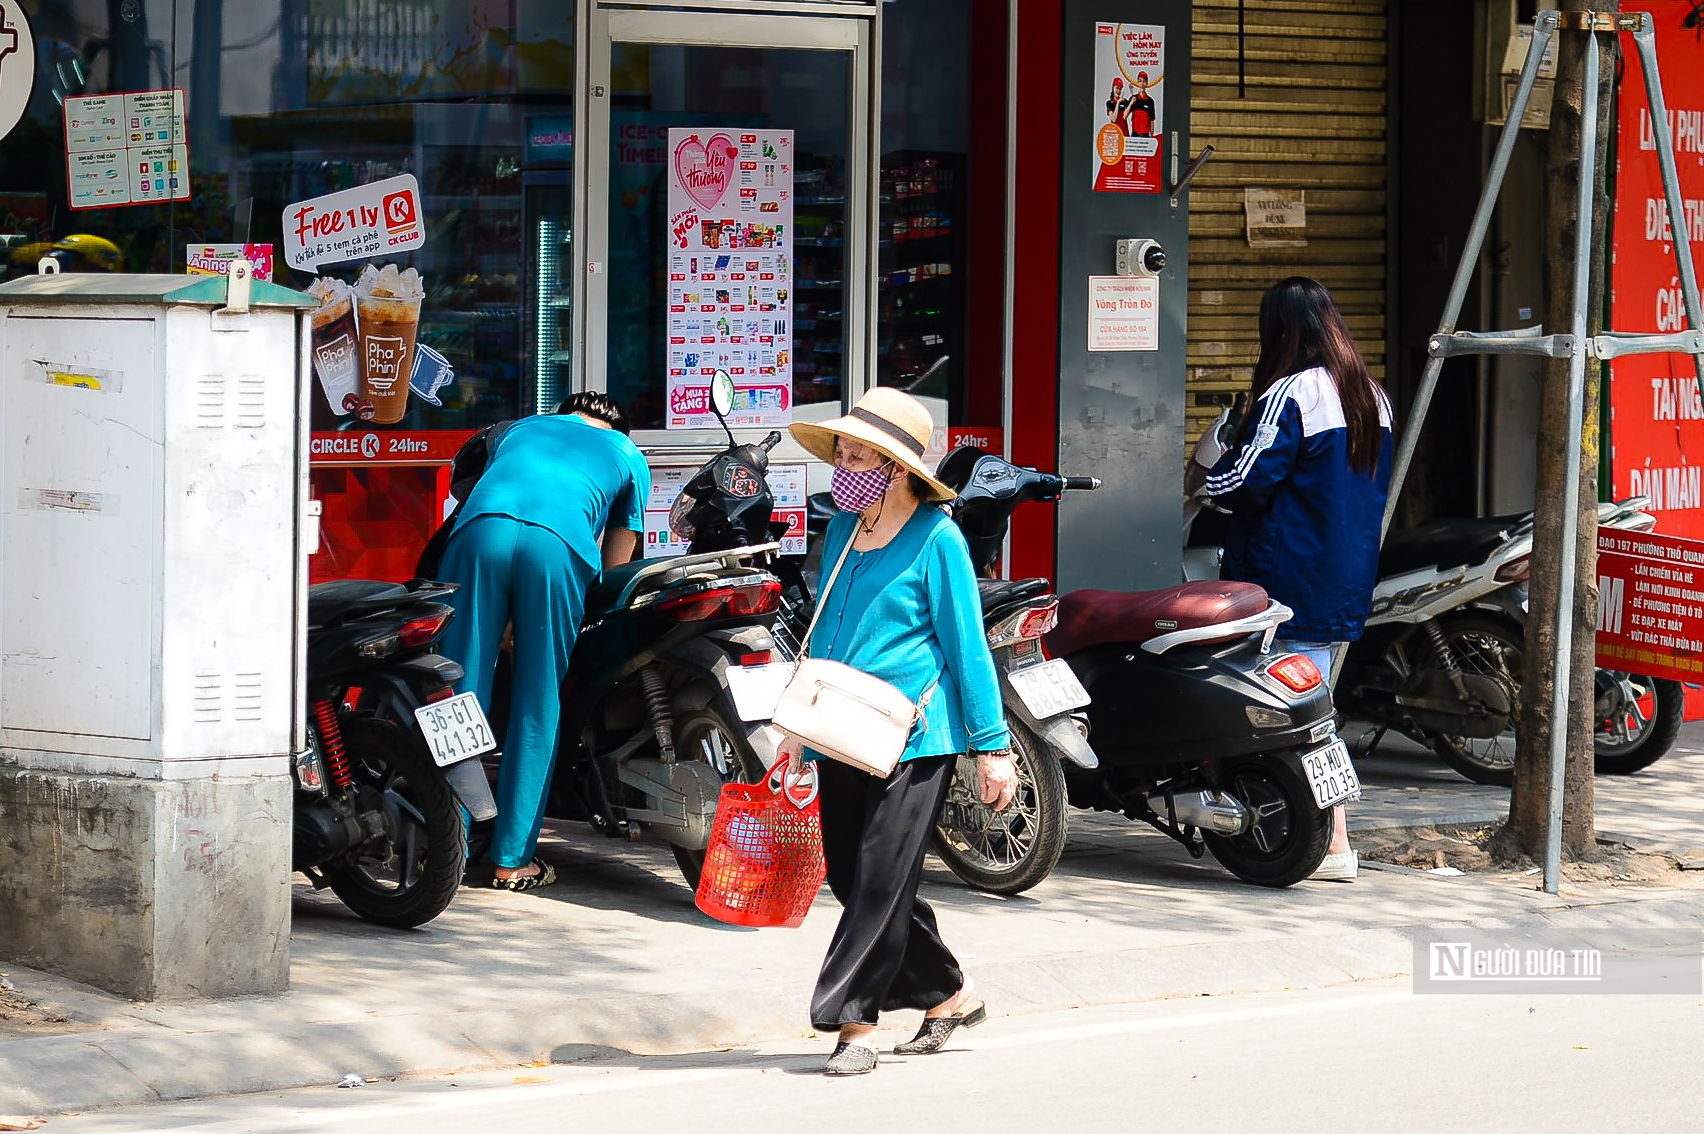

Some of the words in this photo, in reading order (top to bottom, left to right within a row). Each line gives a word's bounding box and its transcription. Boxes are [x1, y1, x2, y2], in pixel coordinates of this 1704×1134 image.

[1122, 32, 1137, 42] VIỆC
[1138, 32, 1153, 41] LÀM
[706, 150, 726, 175] Yêu
[686, 163, 725, 192] thương
[294, 206, 345, 246] Free
[346, 208, 356, 228] 1
[360, 205, 378, 228] ly
[673, 214, 698, 241] MỚI
[326, 243, 332, 253] 5
[333, 240, 350, 251] tem
[351, 236, 361, 248] cà
[363, 230, 379, 246] phê
[388, 237, 398, 246] CK
[400, 232, 420, 244] CLUB
[346, 246, 363, 258] trên
[365, 242, 380, 254] app
[1096, 298, 1117, 312] Vòng
[1118, 298, 1138, 309] Tròn
[1140, 297, 1152, 309] Đỏ
[322, 346, 345, 364] Pha
[369, 342, 394, 359] Pha
[686, 388, 704, 399] MUA
[1651, 376, 1677, 421] TAI
[674, 397, 703, 414] TẶNG
[311, 438, 358, 454] CIRCLE
[364, 436, 380, 458] K
[389, 438, 428, 454] 24hrs
[954, 434, 988, 448] 24hrs
[1666, 454, 1702, 510] MÀN
[1599, 536, 1615, 551] ĐẠO
[1617, 540, 1631, 552] 197
[1666, 544, 1682, 560] THỔ
[1650, 566, 1671, 581] CHIẾM
[1635, 580, 1650, 593] LÀM
[1664, 586, 1681, 598] KINH
[1631, 614, 1640, 626] XE
[1657, 618, 1666, 631] XE
[1668, 620, 1683, 634] MÁY
[1014, 656, 1031, 665] HONDA
[426, 699, 472, 733] 36-G1
[434, 724, 490, 760] 441.32
[1316, 768, 1356, 804] 220.35
